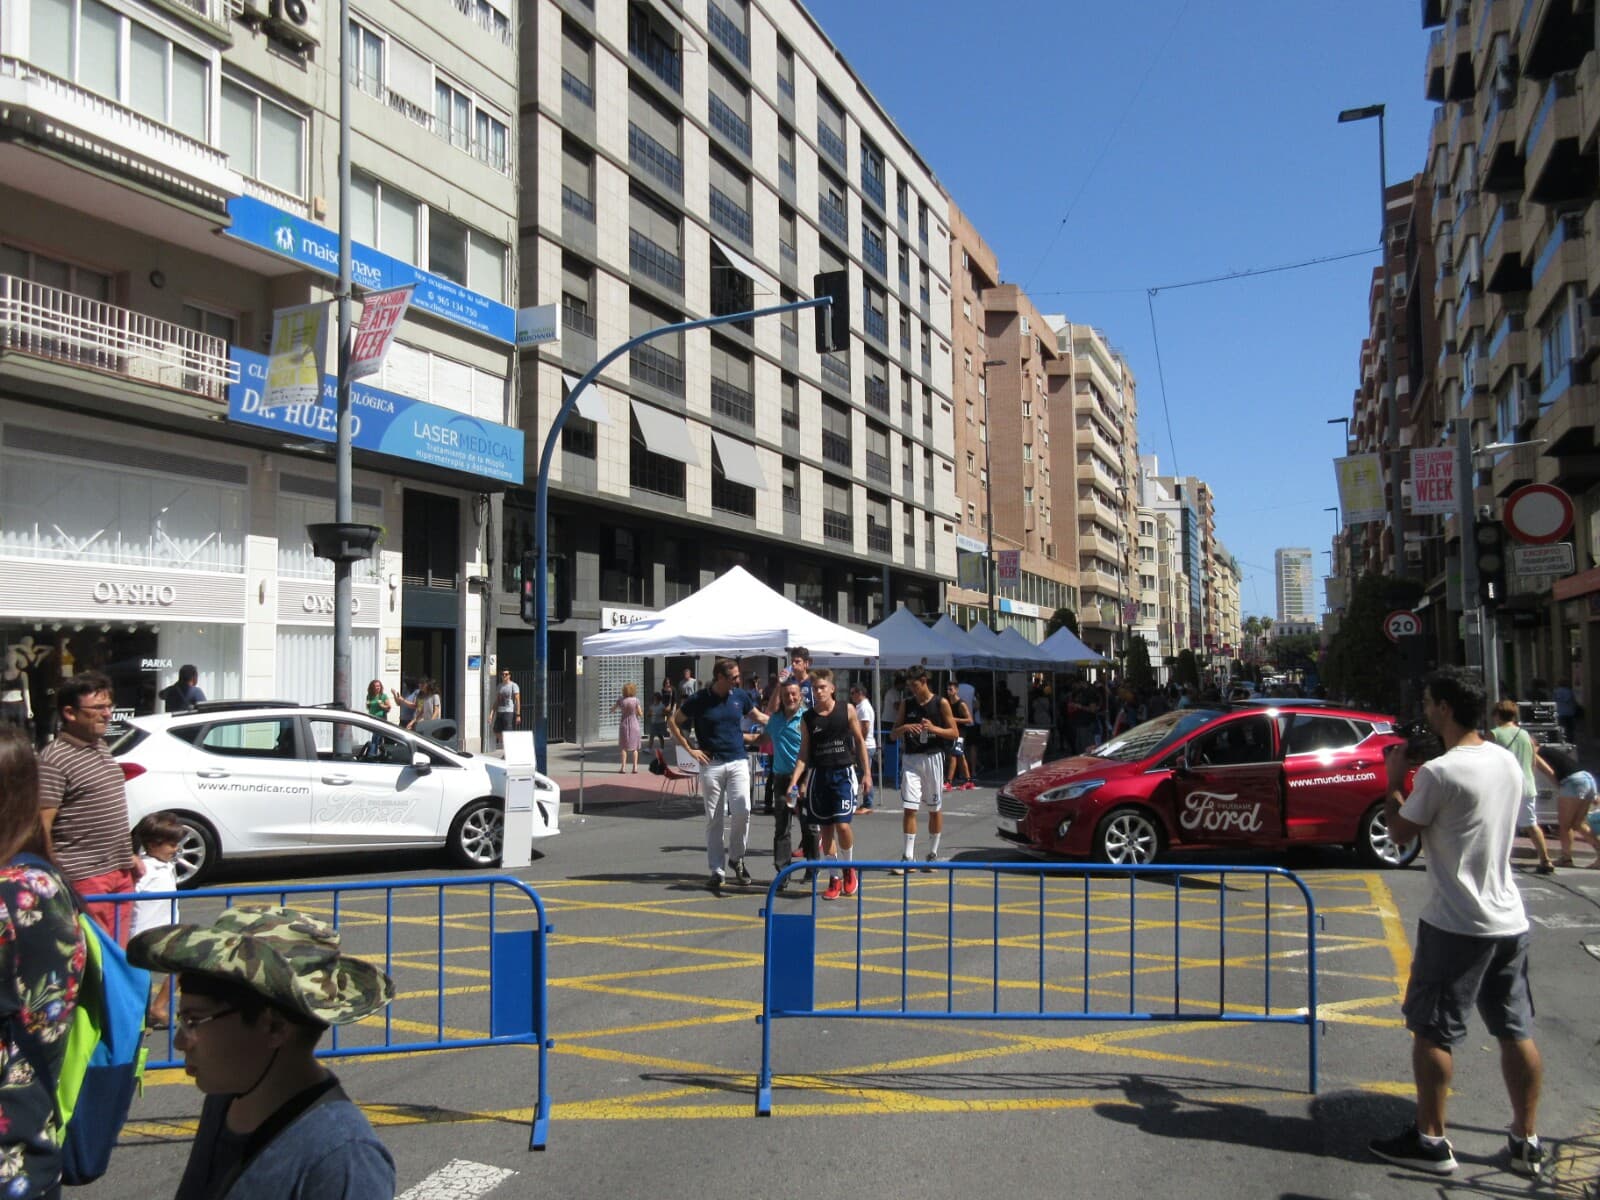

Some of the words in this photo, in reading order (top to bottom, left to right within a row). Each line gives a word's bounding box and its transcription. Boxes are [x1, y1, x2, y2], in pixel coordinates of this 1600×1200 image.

[438, 295, 450, 308] 965
[369, 306, 402, 331] AFW
[284, 401, 362, 438] HUEO
[1428, 463, 1453, 478] AFW
[1415, 479, 1454, 501] WEEK
[93, 581, 177, 607] OYSHO
[303, 594, 361, 615] OYSO
[1391, 620, 1414, 633] 20
[142, 658, 173, 668] PARKA
[197, 782, 310, 795] www.mundicar.com
[1288, 771, 1376, 788] www.mundicar.com
[315, 790, 416, 826] Ford
[841, 799, 851, 810] 15
[1180, 791, 1263, 832] Ford
